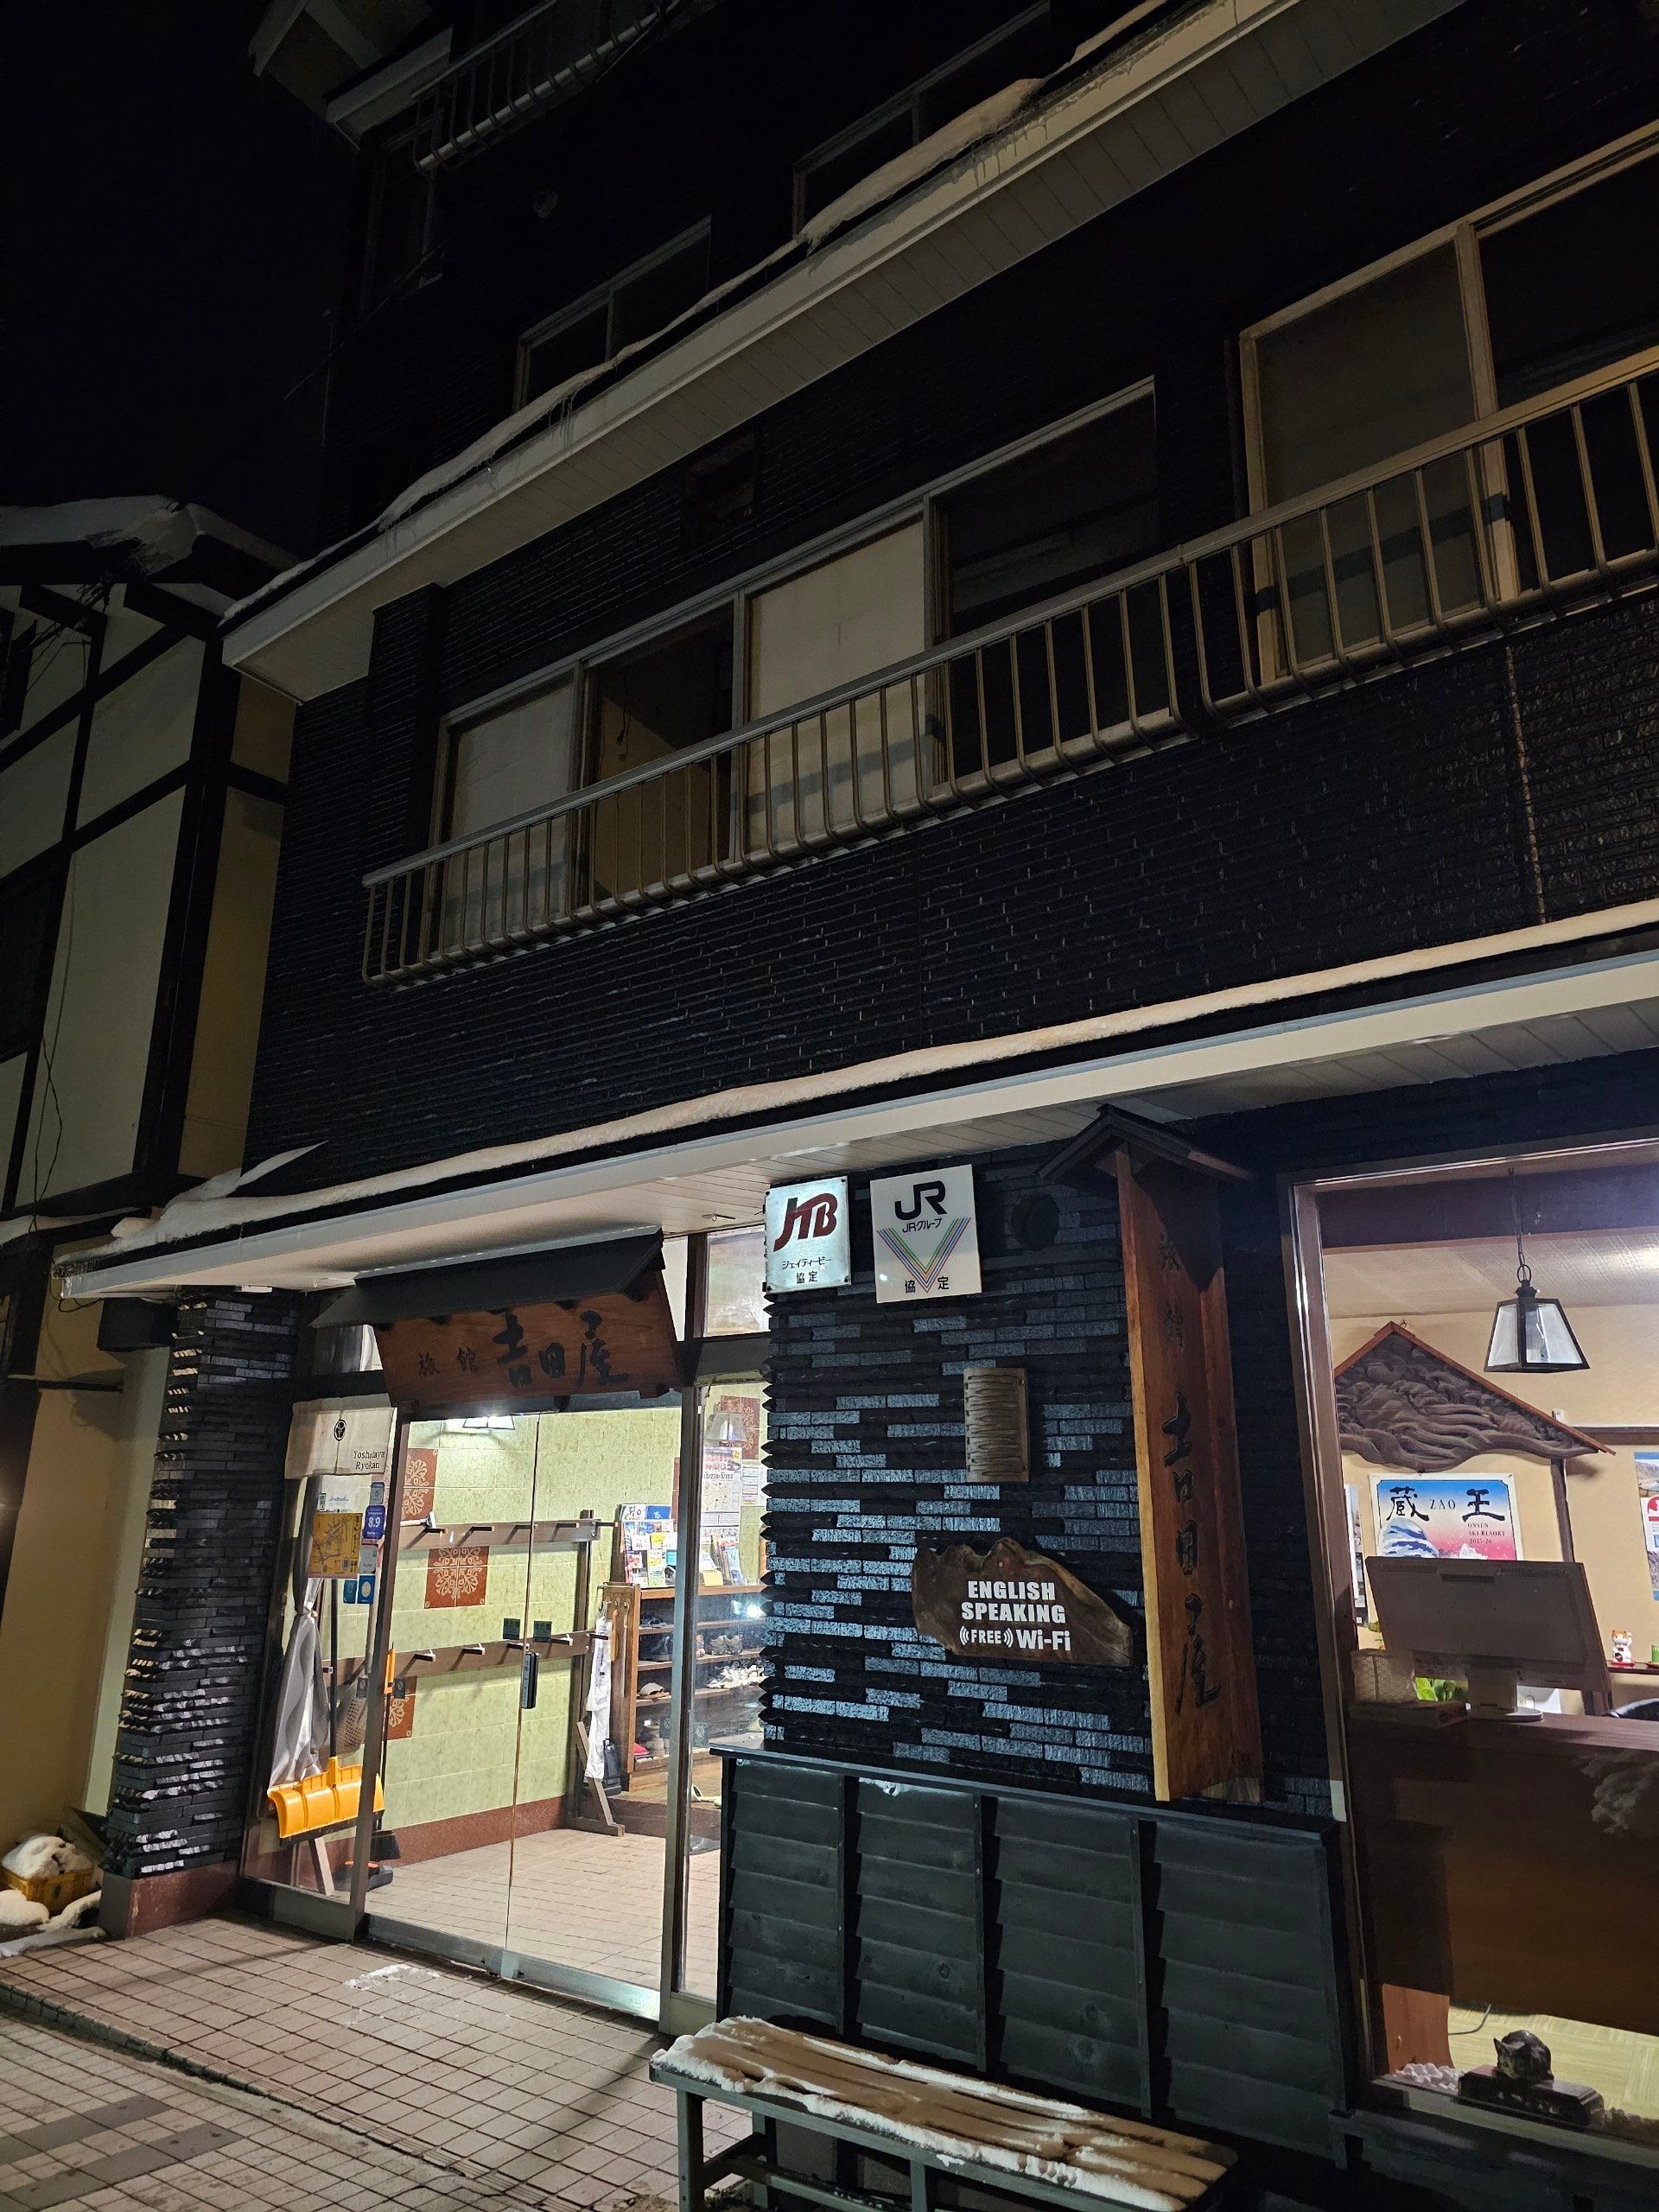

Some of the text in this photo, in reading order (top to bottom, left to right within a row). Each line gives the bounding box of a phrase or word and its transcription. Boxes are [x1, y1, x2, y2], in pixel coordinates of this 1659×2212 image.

[894, 1180, 947, 1220] JR
[773, 1192, 838, 1252] JTB
[902, 1217, 943, 1233] JRグループ
[782, 1256, 832, 1269] ジェイティービー
[796, 1271, 818, 1284] 協定
[353, 1450, 385, 1460] Yoshidaya
[355, 1461, 380, 1471] Ryokan
[1429, 1499, 1456, 1510] ZAO
[368, 1516, 381, 1528] 8.9
[968, 1580, 1055, 1600] ENGLISH
[961, 1601, 1066, 1624] SPEAKING
[970, 1629, 1071, 1651] FREE Wi-Fi
